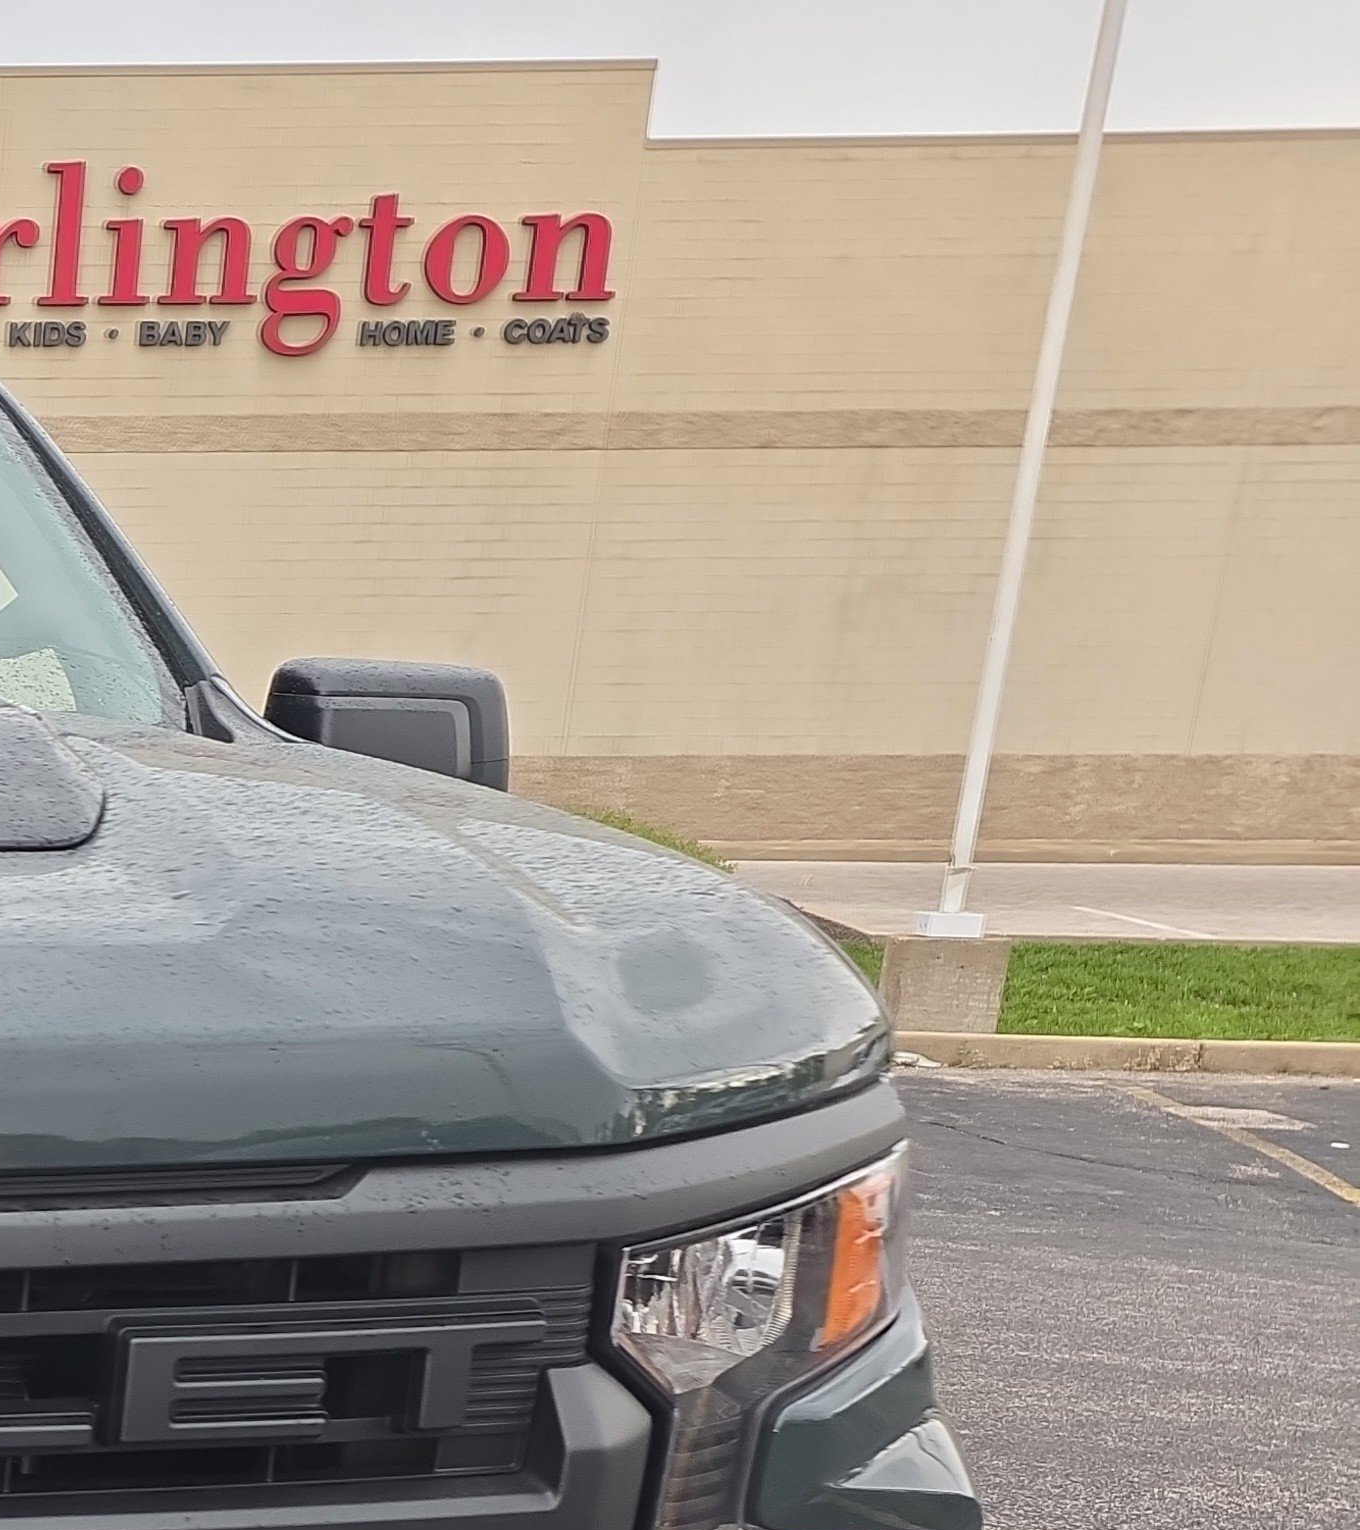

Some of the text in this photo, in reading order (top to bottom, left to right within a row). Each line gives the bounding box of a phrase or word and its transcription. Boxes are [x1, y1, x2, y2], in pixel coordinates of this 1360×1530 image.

[9, 321, 87, 347] KIDS
[138, 321, 227, 346] BABY
[362, 320, 456, 347] HOME
[506, 314, 610, 344] COATS
